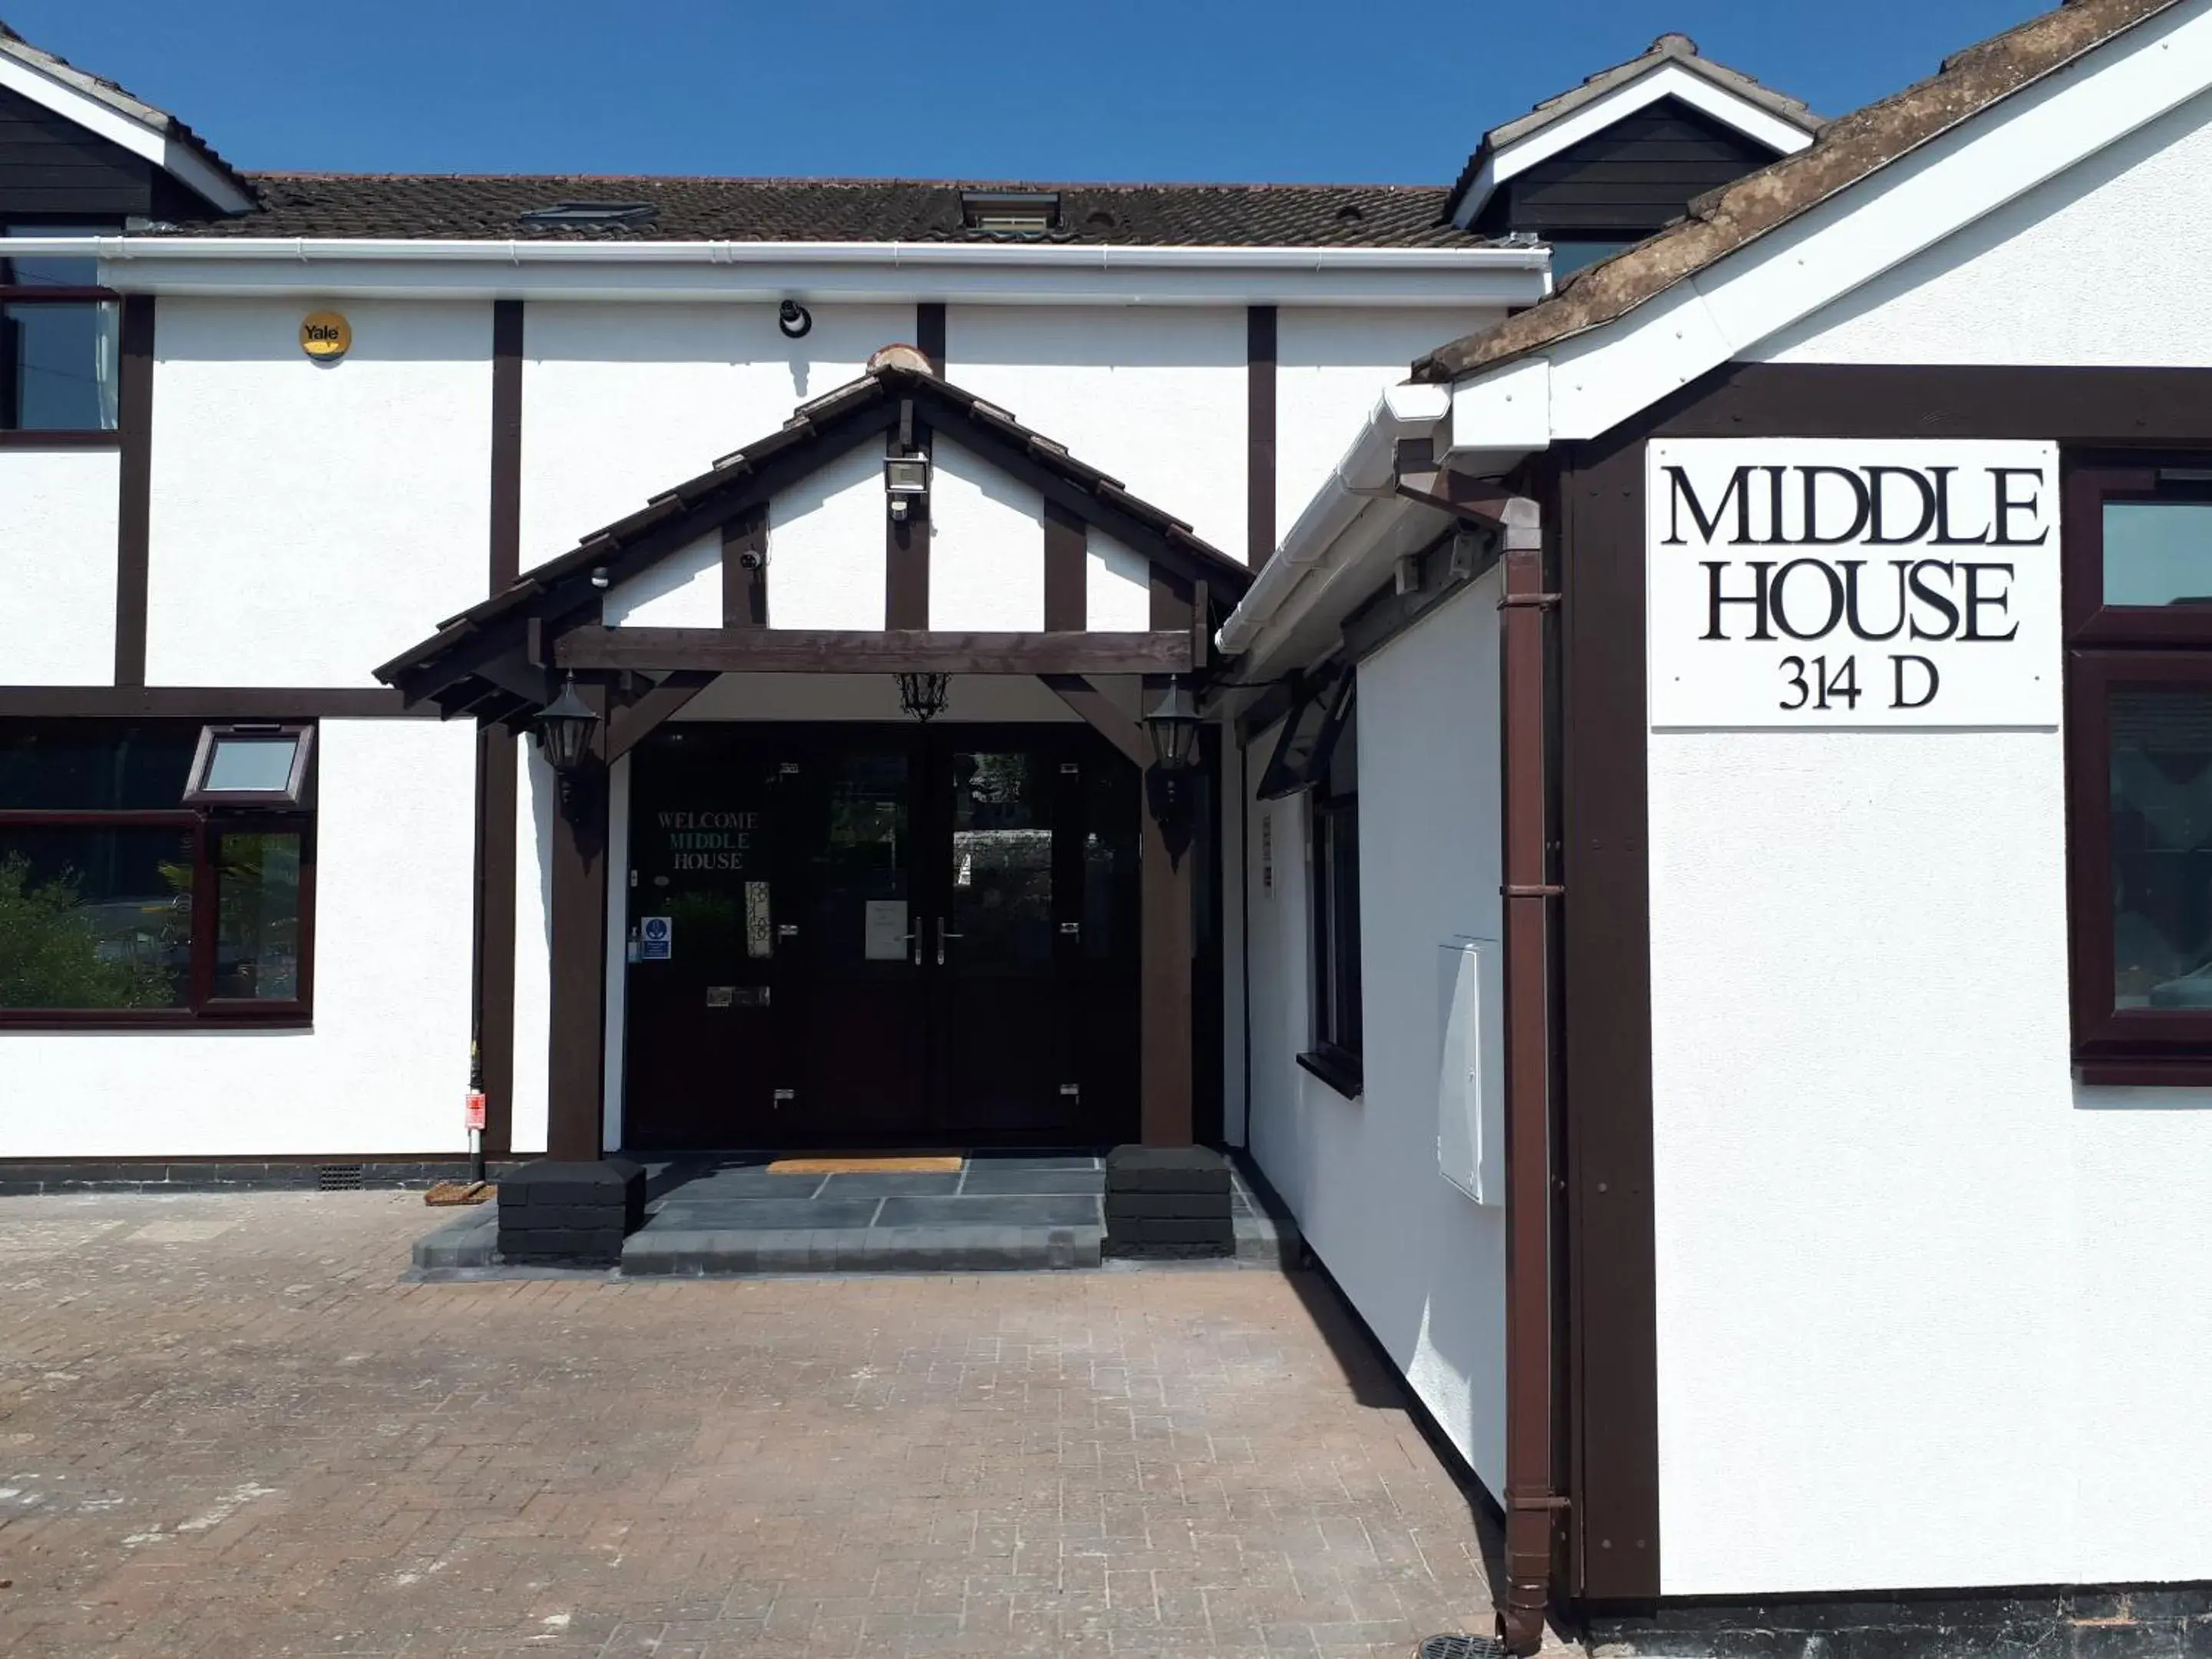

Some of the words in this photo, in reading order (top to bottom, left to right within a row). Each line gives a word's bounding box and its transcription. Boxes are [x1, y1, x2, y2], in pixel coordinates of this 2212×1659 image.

[305, 324, 339, 339] Yale
[1661, 465, 2050, 546] MIDDLE
[1698, 558, 2020, 642] HOUSE
[1778, 654, 1862, 710] 314
[1887, 654, 1939, 710] D
[658, 811, 759, 829] WELCOME
[670, 832, 750, 849] MIDDLE
[673, 852, 744, 870] HOUSE
